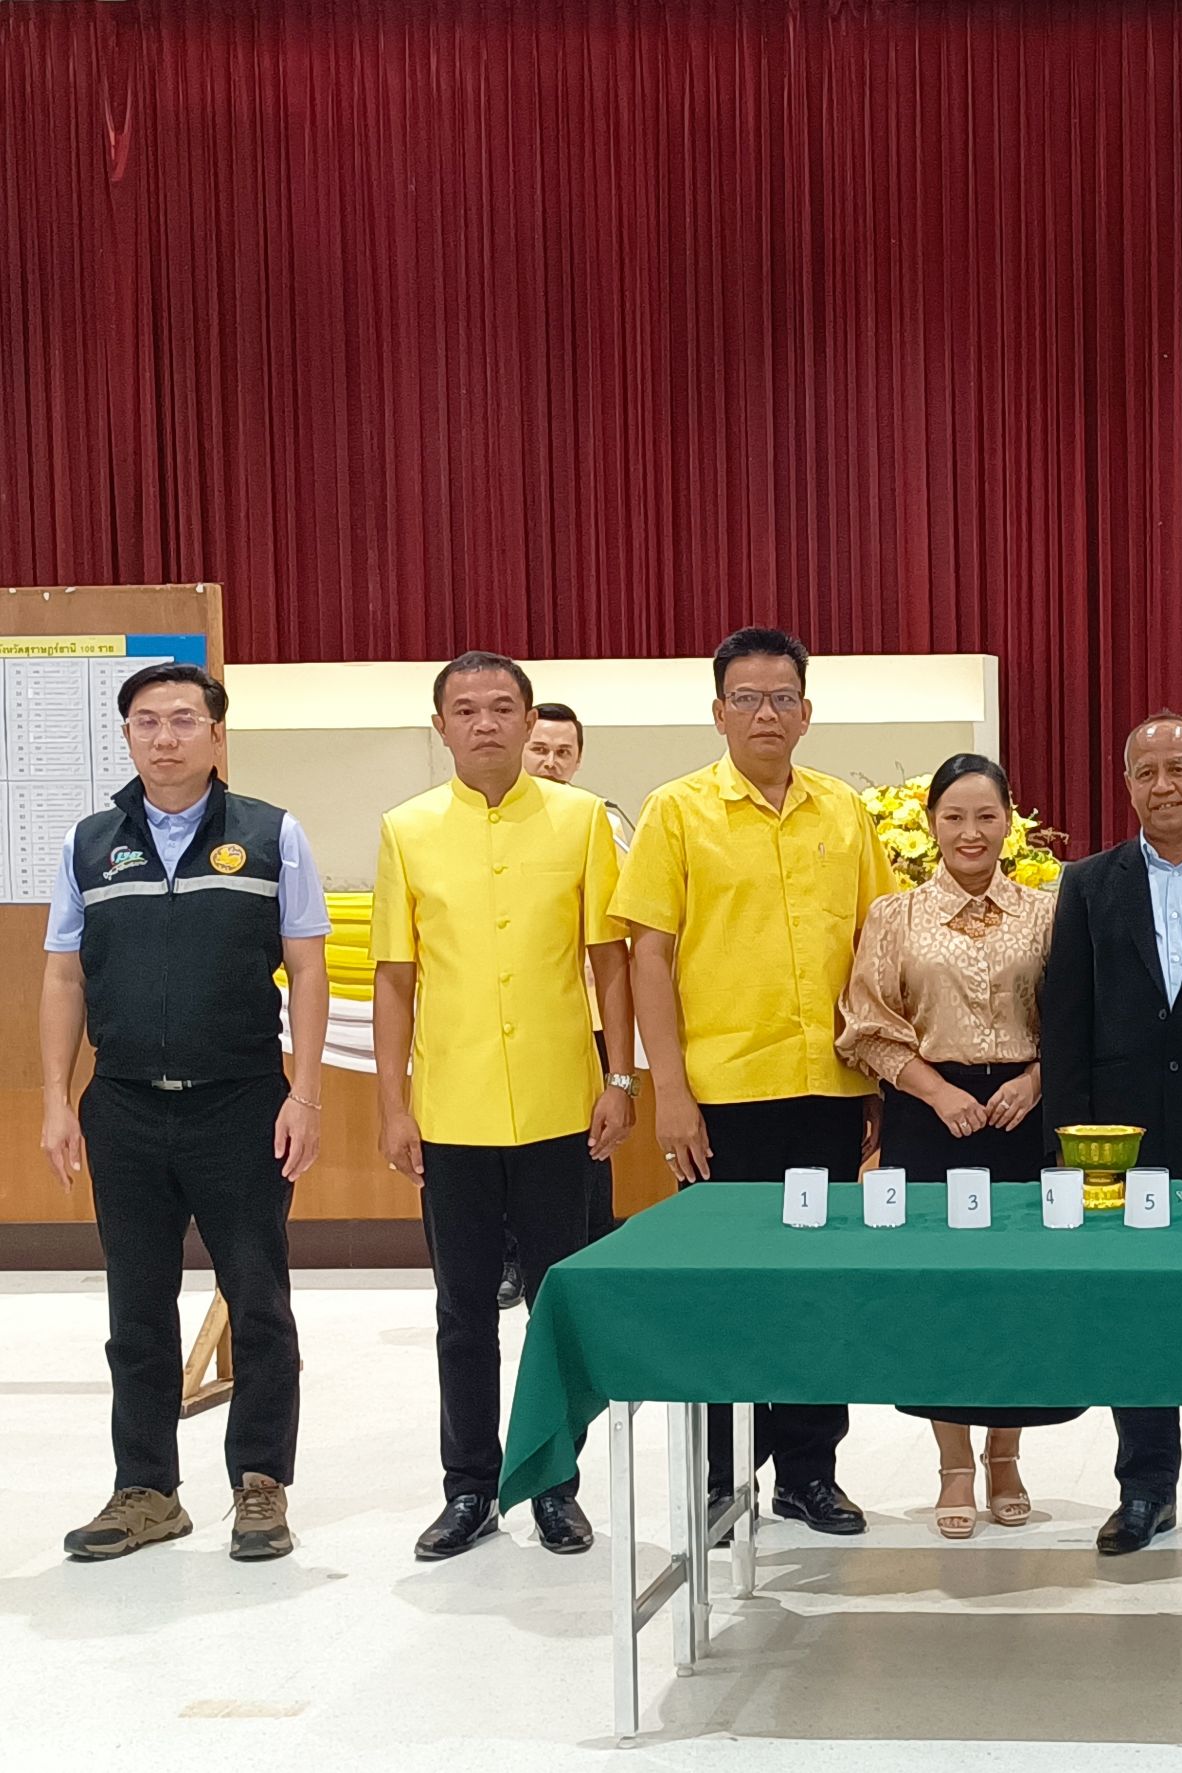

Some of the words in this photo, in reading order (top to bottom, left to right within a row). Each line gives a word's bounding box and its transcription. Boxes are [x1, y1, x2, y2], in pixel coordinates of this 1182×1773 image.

[800, 1192, 809, 1208] 1
[886, 1188, 897, 1204] 2
[967, 1194, 978, 1210] 3
[1046, 1188, 1055, 1205] 4
[1144, 1193, 1155, 1210] 5
